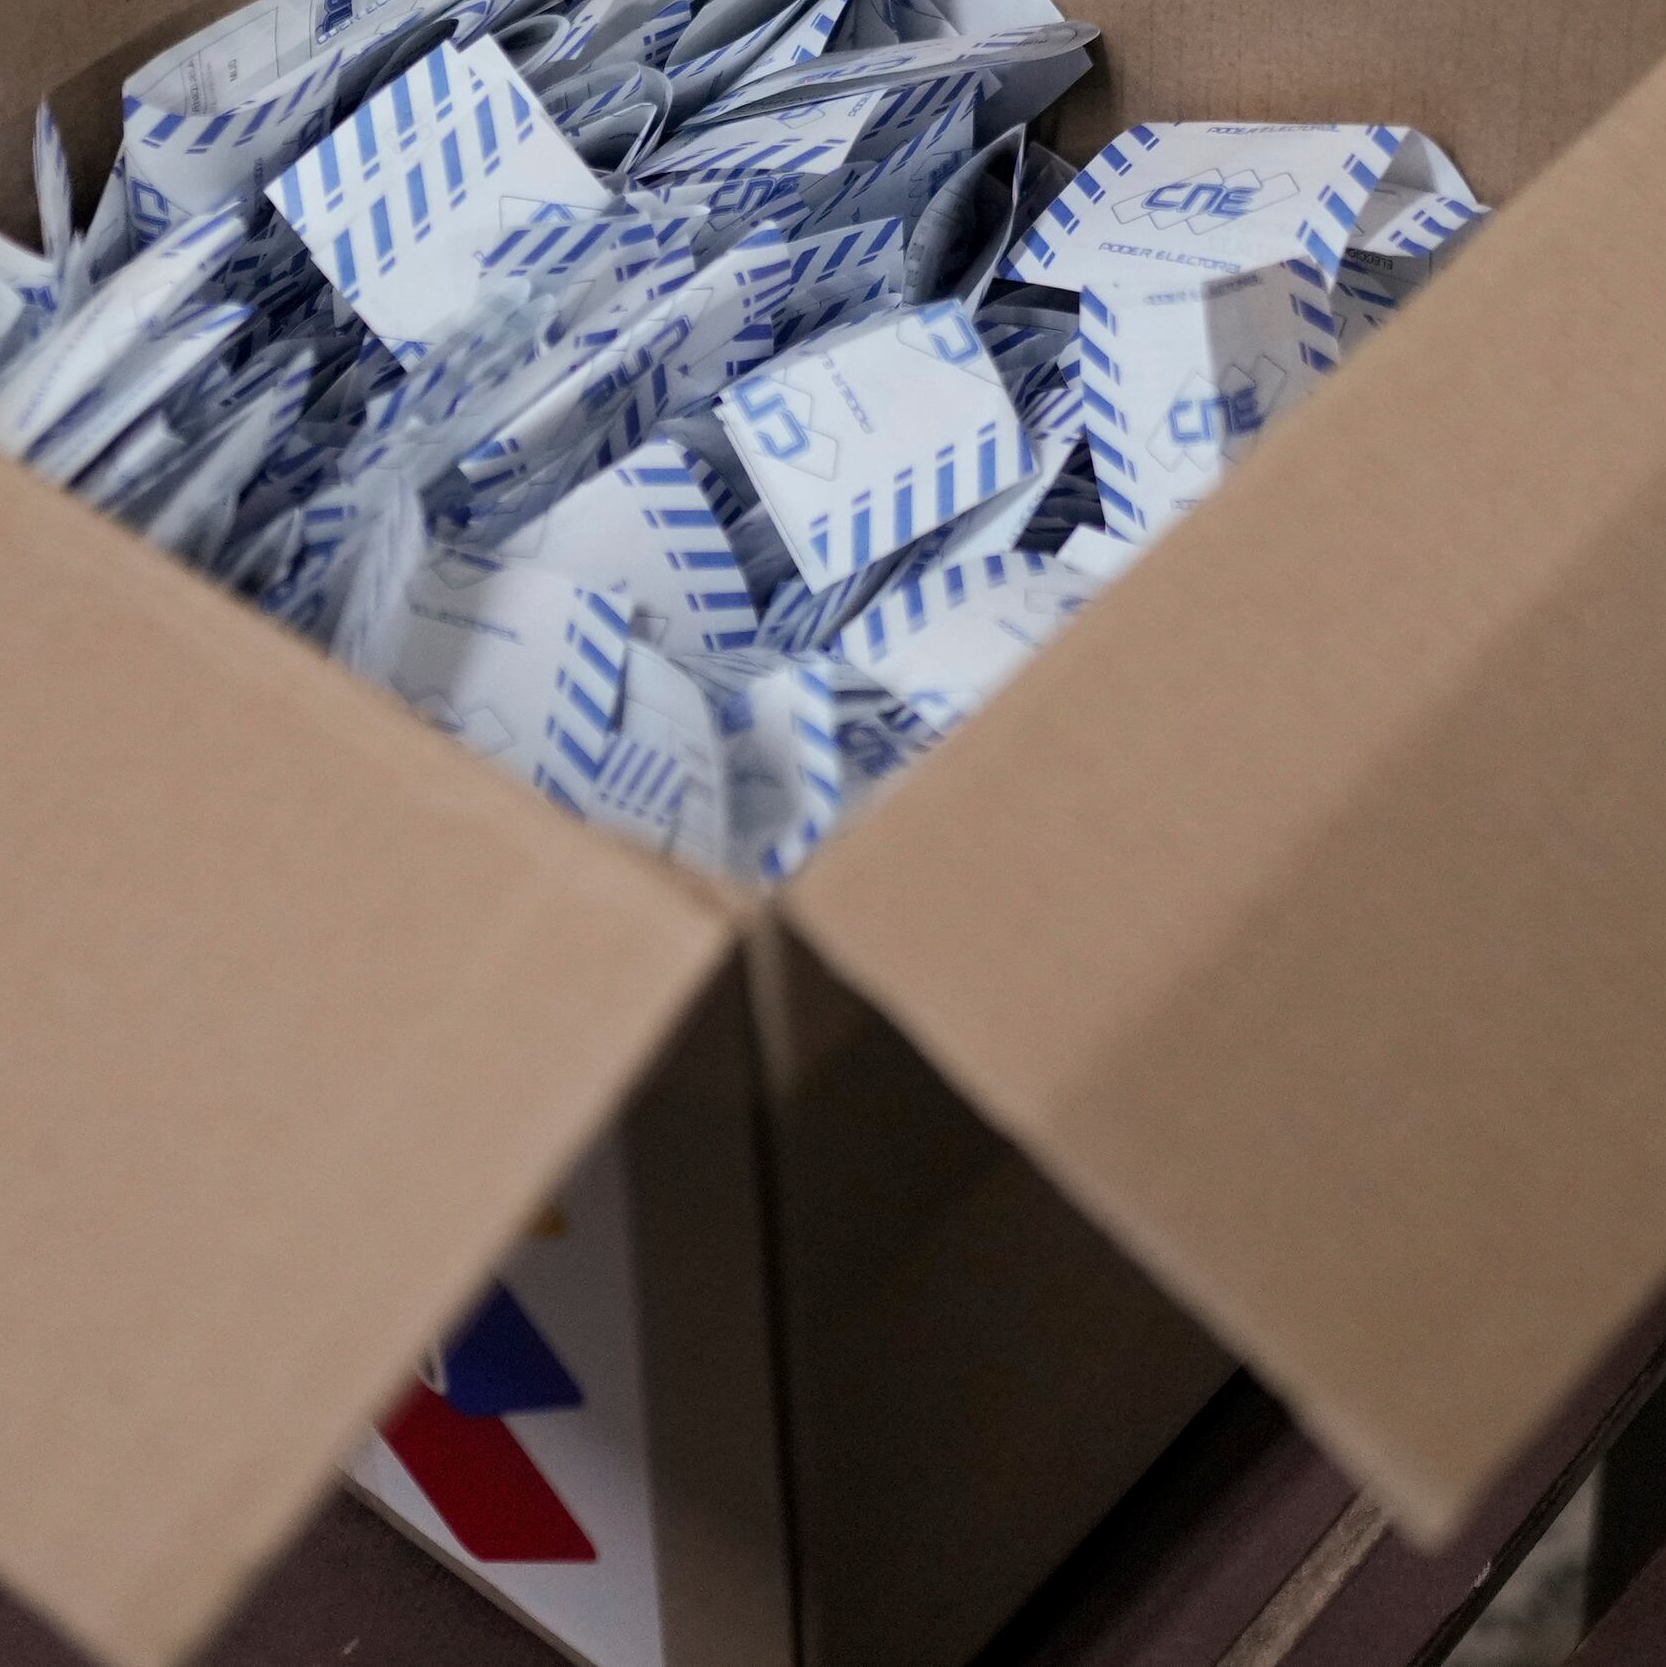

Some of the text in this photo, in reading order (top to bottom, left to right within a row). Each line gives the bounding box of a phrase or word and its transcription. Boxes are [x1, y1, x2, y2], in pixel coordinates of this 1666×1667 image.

[1143, 182, 1258, 221] CNE
[1098, 242, 1242, 273] PODER ELECTORAL
[1167, 389, 1265, 444] CNE
